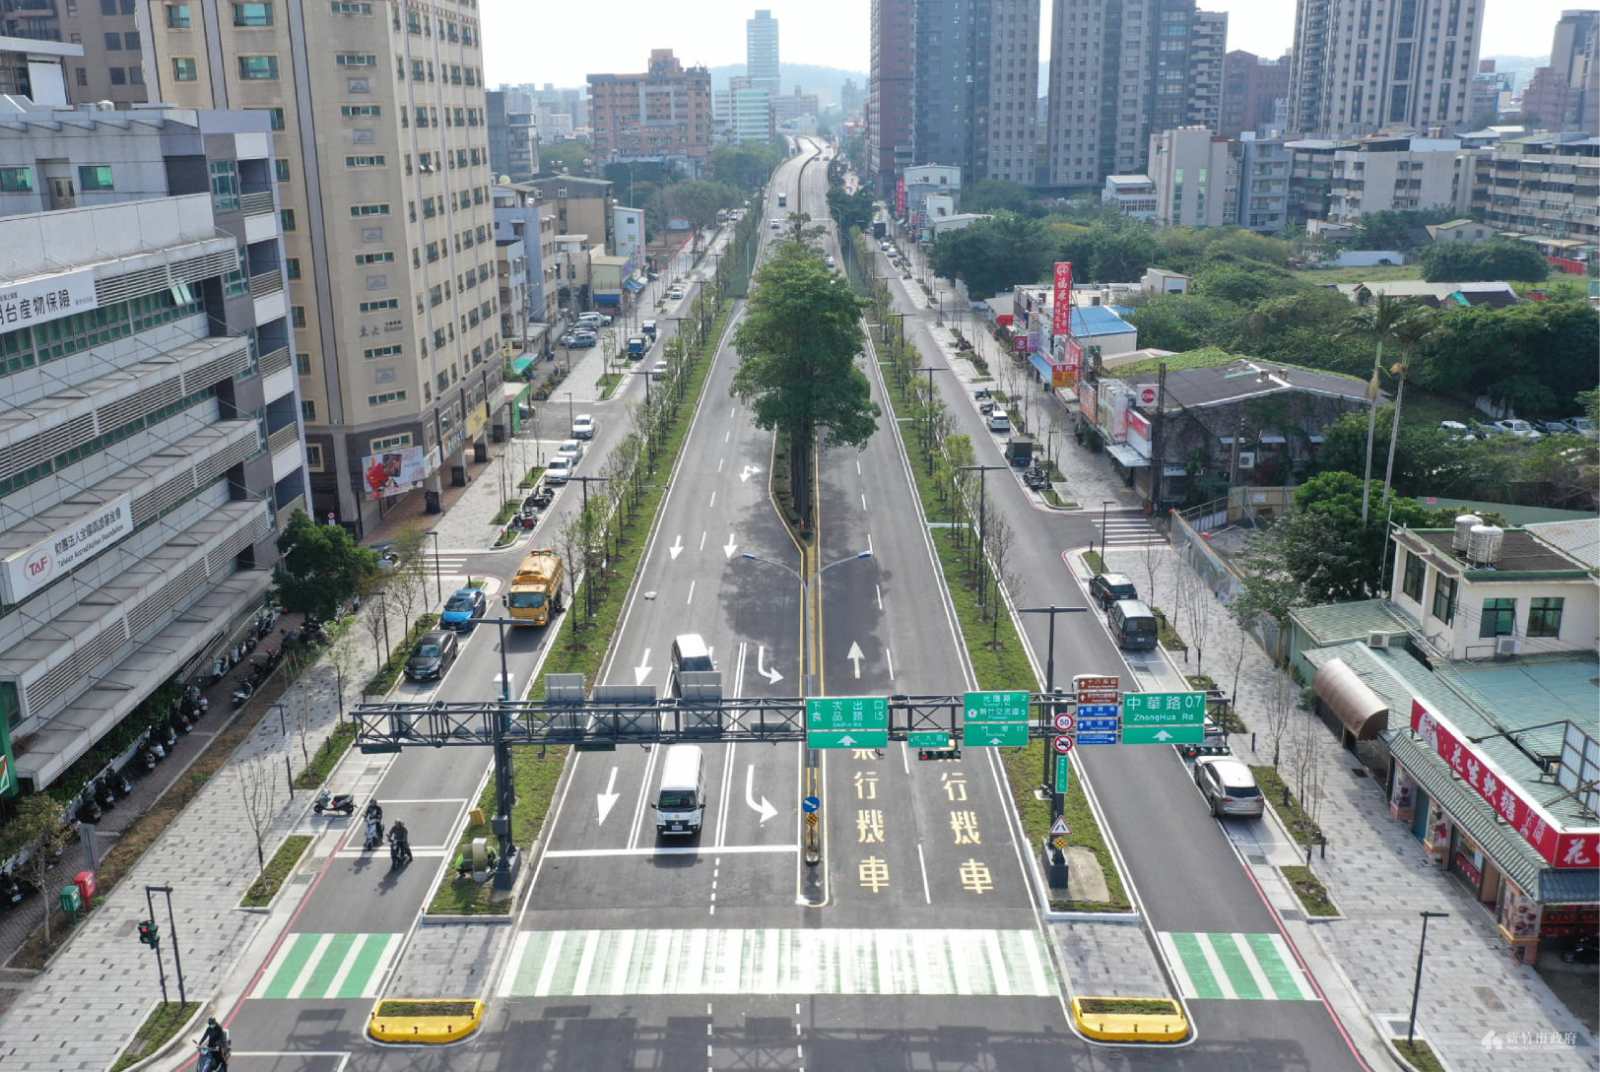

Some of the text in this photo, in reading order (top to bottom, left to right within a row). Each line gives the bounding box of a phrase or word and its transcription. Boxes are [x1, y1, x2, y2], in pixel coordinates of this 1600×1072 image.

[29, 555, 49, 577] TAF
[1126, 695, 1181, 712] 中華路
